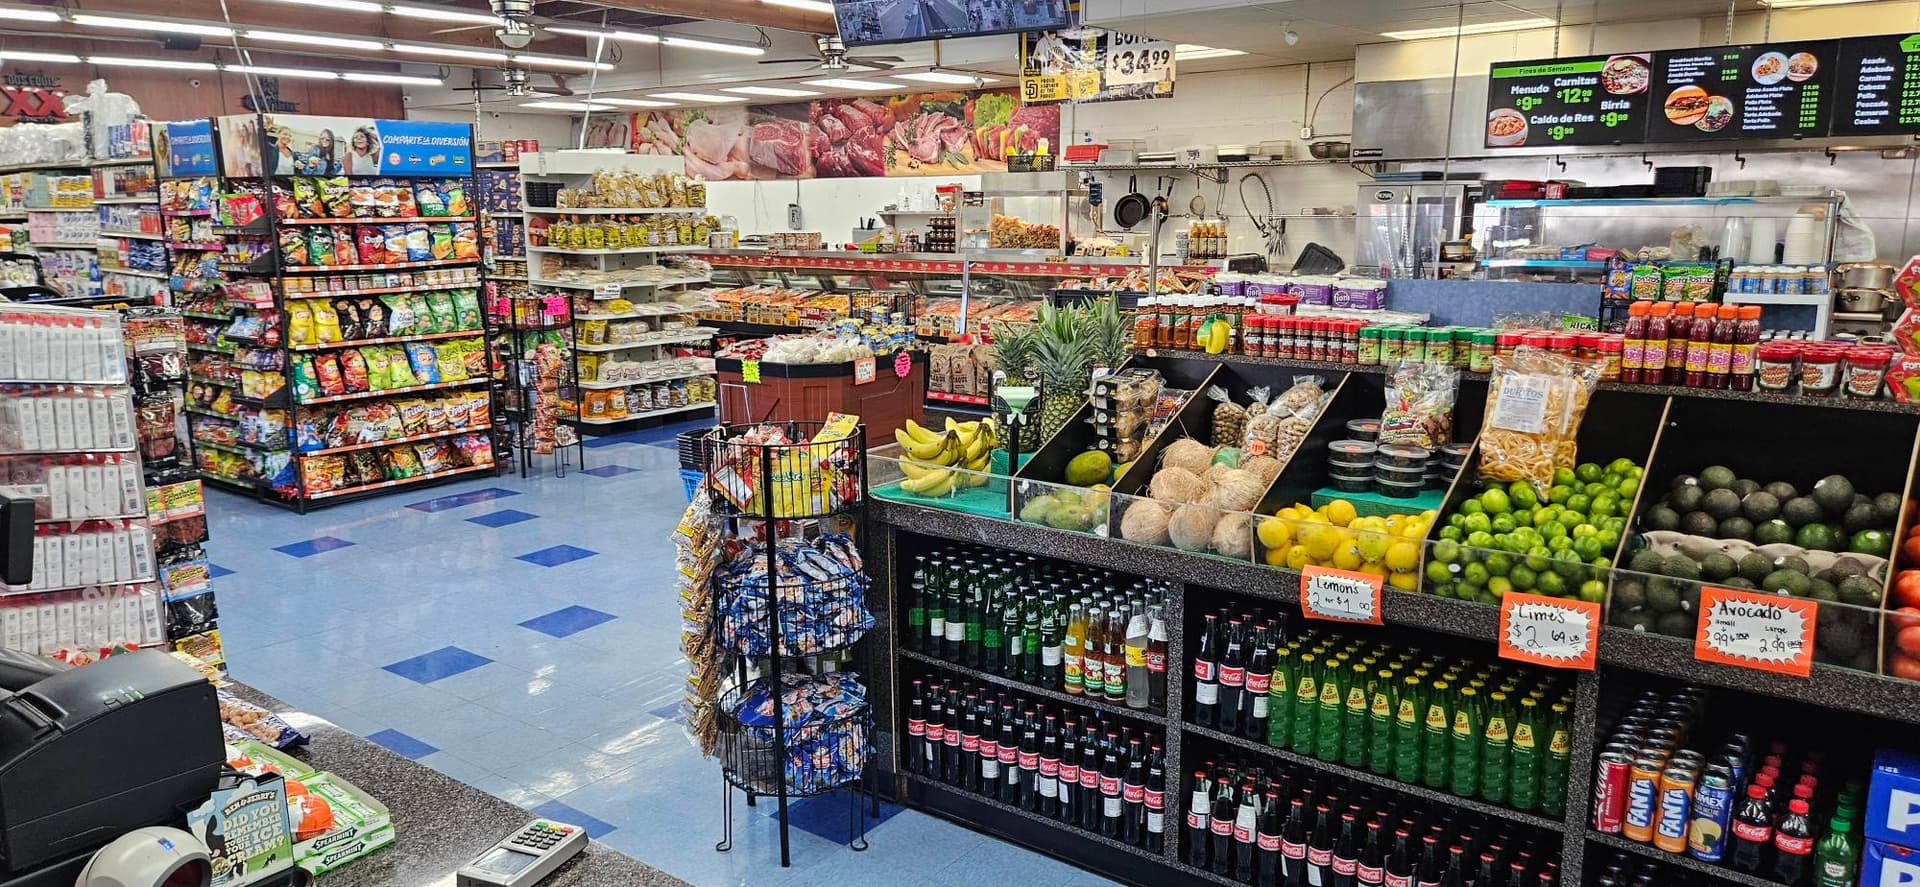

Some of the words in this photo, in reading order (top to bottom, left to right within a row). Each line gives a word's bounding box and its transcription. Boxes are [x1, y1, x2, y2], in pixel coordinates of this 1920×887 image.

[1511, 84, 1550, 96] Menudo
[1553, 76, 1597, 88] Carnitas
[1601, 100, 1631, 112] Birria
[1531, 115, 1558, 125] Caldo
[1559, 115, 1574, 124] de
[1575, 113, 1595, 123] Res
[383, 135, 423, 144] COMPARTE
[1312, 592, 1323, 608] 2
[1719, 601, 1782, 621] Avocado
[1551, 630, 1566, 644] 69
[225, 802, 241, 816] BEN
[246, 790, 276, 806] JERRY'S
[1625, 779, 1651, 828] FANTA
[224, 813, 249, 830] DID
[251, 802, 281, 820] YOU
[1658, 788, 1684, 838] FANTA
[224, 814, 284, 841] REMEMBER
[1737, 822, 1767, 837] Coca-Cola
[224, 839, 237, 849] TO
[237, 836, 250, 846] GET
[225, 841, 252, 856] YOUR
[251, 822, 284, 841] ICE
[314, 828, 356, 850] SPEARMINT
[1775, 833, 1803, 850] Coca-Cola
[226, 836, 286, 866] CREAM?
[325, 843, 365, 865] SPEARMINT
